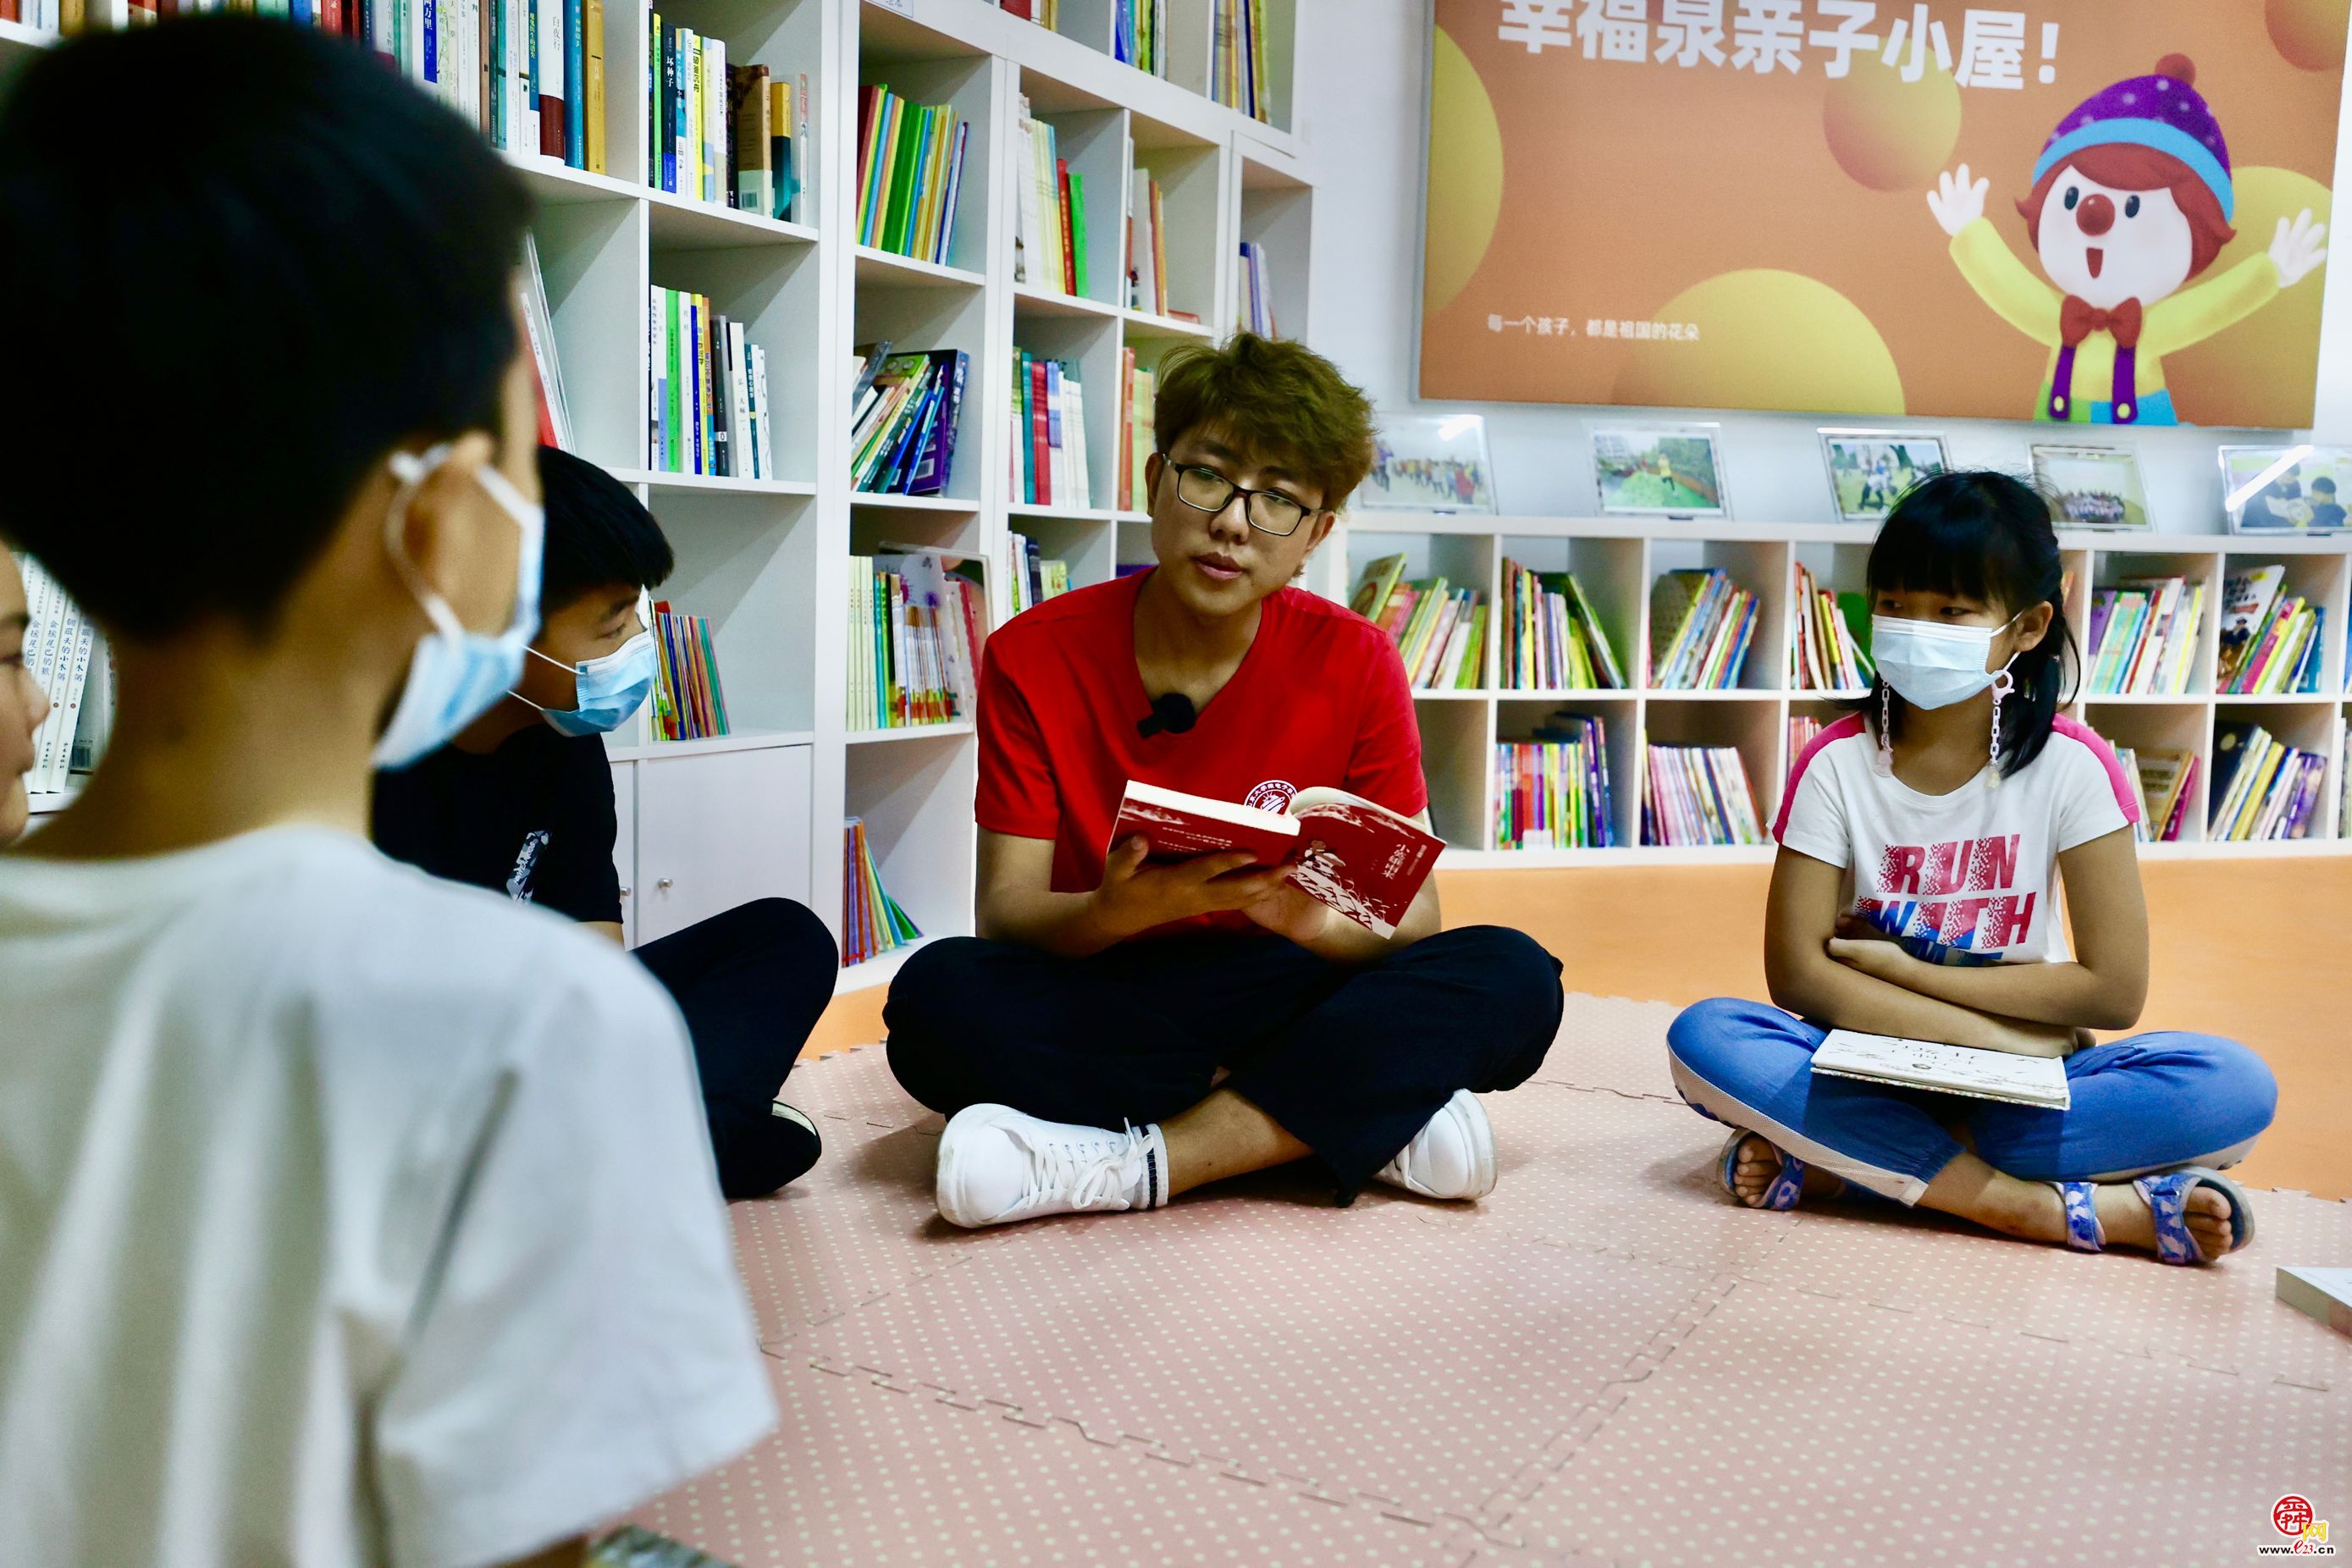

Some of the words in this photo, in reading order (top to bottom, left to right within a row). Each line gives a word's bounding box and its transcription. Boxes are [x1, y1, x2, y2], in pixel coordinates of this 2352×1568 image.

[552, 15, 561, 51] 白夜行
[665, 55, 674, 87] 坏种子
[1488, 312, 1700, 340] 每一个孩子，都是祖国的花朵
[1877, 834, 2020, 896] RUN
[1855, 892, 2036, 949] WITH
